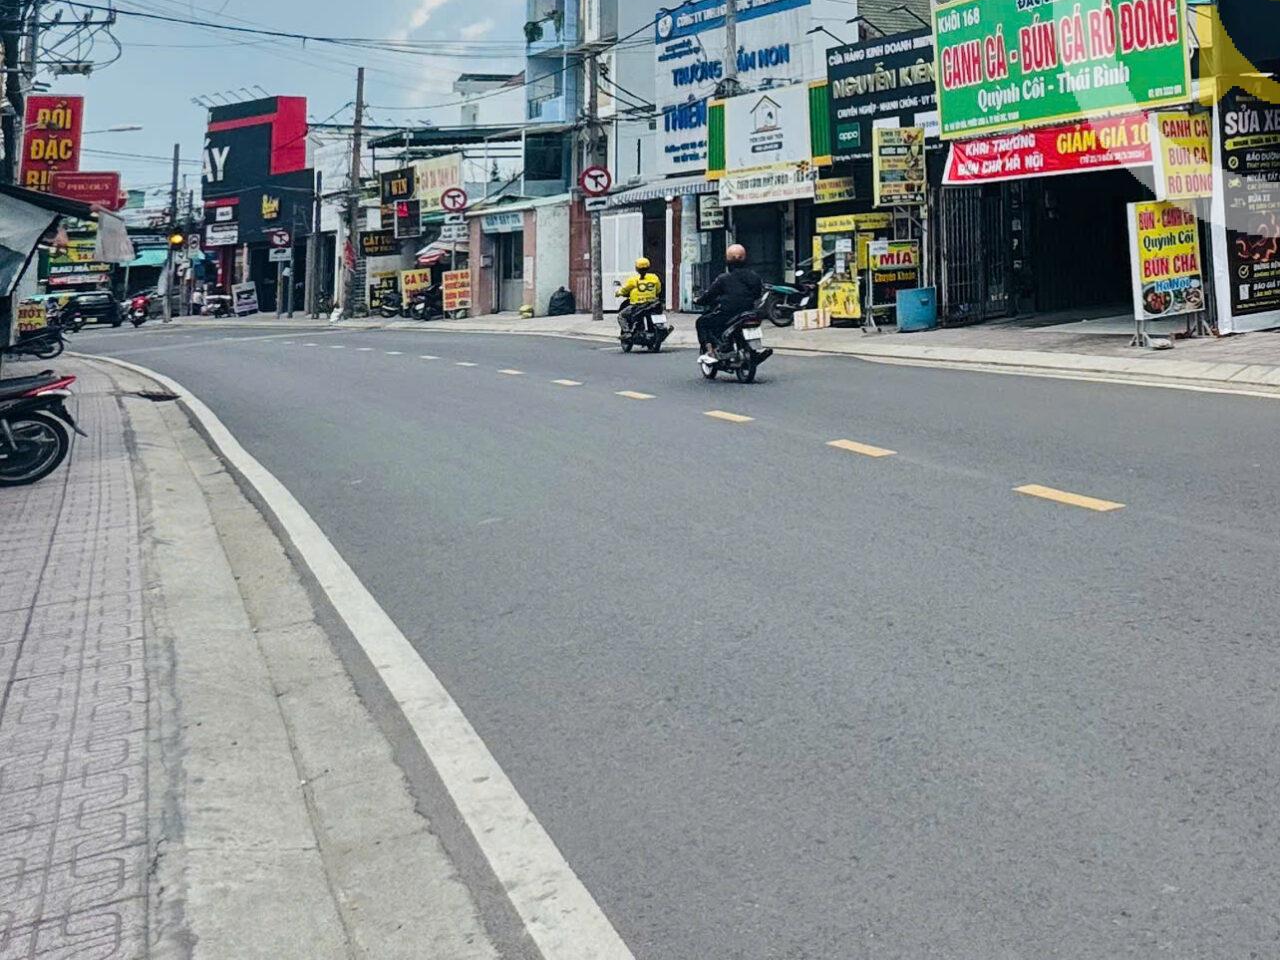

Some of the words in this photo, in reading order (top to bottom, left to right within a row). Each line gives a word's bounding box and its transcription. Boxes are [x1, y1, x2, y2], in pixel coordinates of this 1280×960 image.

[962, 8, 980, 27] 168
[758, 43, 790, 69] NON
[941, 39, 983, 89] CANH
[984, 23, 1008, 81] CÁ
[1019, 13, 1058, 74] BÚN
[1059, 3, 1087, 66] CÁ
[978, 84, 1020, 112] Quỳnh
[1023, 76, 1044, 100] Côi
[1056, 67, 1090, 94] Thái
[1093, 61, 1130, 88] Bình
[1162, 120, 1192, 138] CANH
[1224, 104, 1260, 135] SỬA
[838, 130, 859, 142] oppo
[1057, 125, 1096, 155] GIẢM
[1100, 119, 1129, 150] GIÁ
[1143, 232, 1176, 252] Quỳnh
[1178, 229, 1194, 244] Côi
[1143, 252, 1169, 278] BÚN
[1173, 245, 1198, 273] CHẢ
